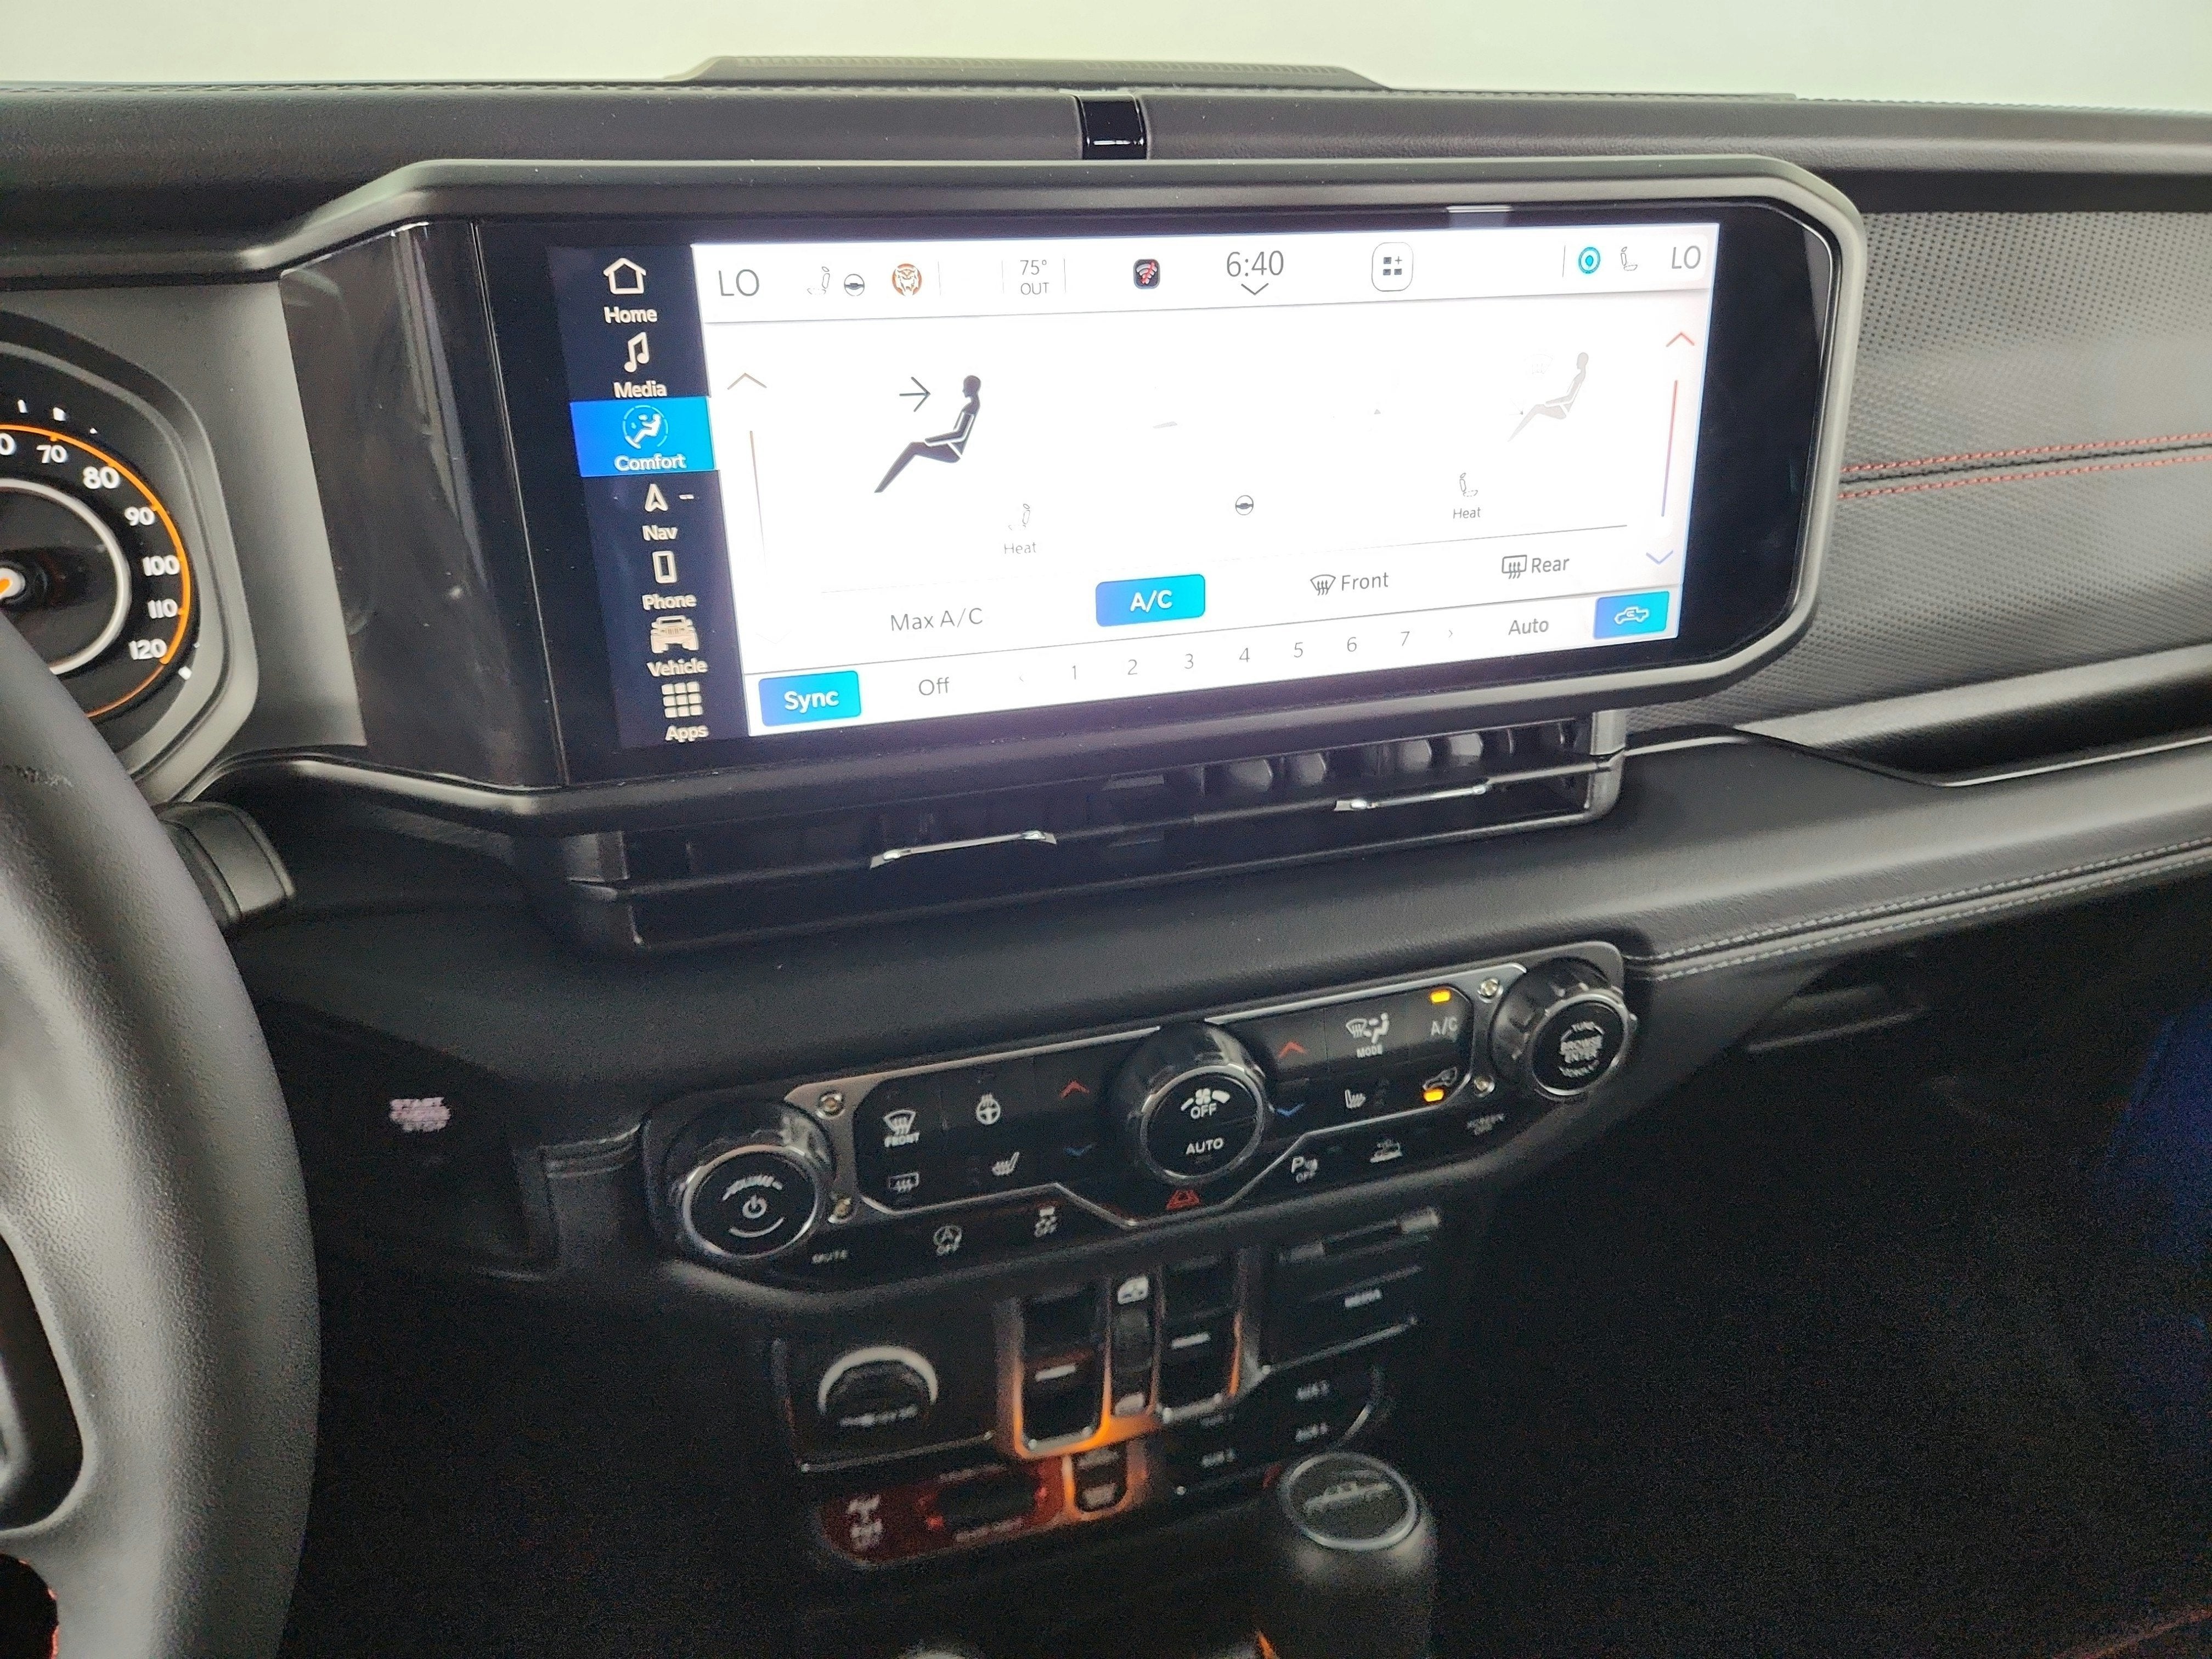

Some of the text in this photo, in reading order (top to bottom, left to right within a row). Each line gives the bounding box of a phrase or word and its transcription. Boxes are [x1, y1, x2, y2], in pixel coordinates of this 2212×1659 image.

[1227, 250, 1284, 277] 6:40
[1672, 246, 1701, 269] LO
[1020, 259, 1047, 275] 75°
[719, 269, 759, 296] LO
[1020, 282, 1049, 295] OUT
[604, 307, 657, 323] Home
[614, 380, 667, 398] Media
[37, 445, 67, 463] 70
[616, 454, 686, 470] Comfort
[83, 466, 120, 489] 80
[125, 507, 154, 526] 90
[1453, 507, 1481, 519] Heat
[642, 525, 678, 540] Nav
[1004, 542, 1036, 554] Heat
[143, 556, 179, 576] 100
[1532, 558, 1570, 573] Rear
[1341, 572, 1389, 591] Front
[148, 599, 177, 618] 110
[642, 594, 696, 610] Phone
[1131, 590, 1171, 612] A/C
[891, 608, 983, 631] Max A/C
[1509, 619, 1549, 635] Auto
[1347, 636, 1357, 652] 6
[1401, 631, 1410, 646] 7
[128, 639, 166, 661] 120
[1239, 647, 1250, 662] 4
[1294, 642, 1303, 658] 5
[647, 658, 708, 676] Vehicle
[1127, 659, 1137, 675] 2
[1184, 653, 1194, 669] 3
[1072, 665, 1076, 680] 1
[918, 676, 949, 696] Off
[785, 691, 838, 713] Sync
[665, 726, 709, 742] Apps
[1431, 1016, 1458, 1036] A/C
[1357, 1044, 1383, 1058] MODE
[1190, 1103, 1216, 1119] OFF
[1186, 1138, 1223, 1154] AUTO
